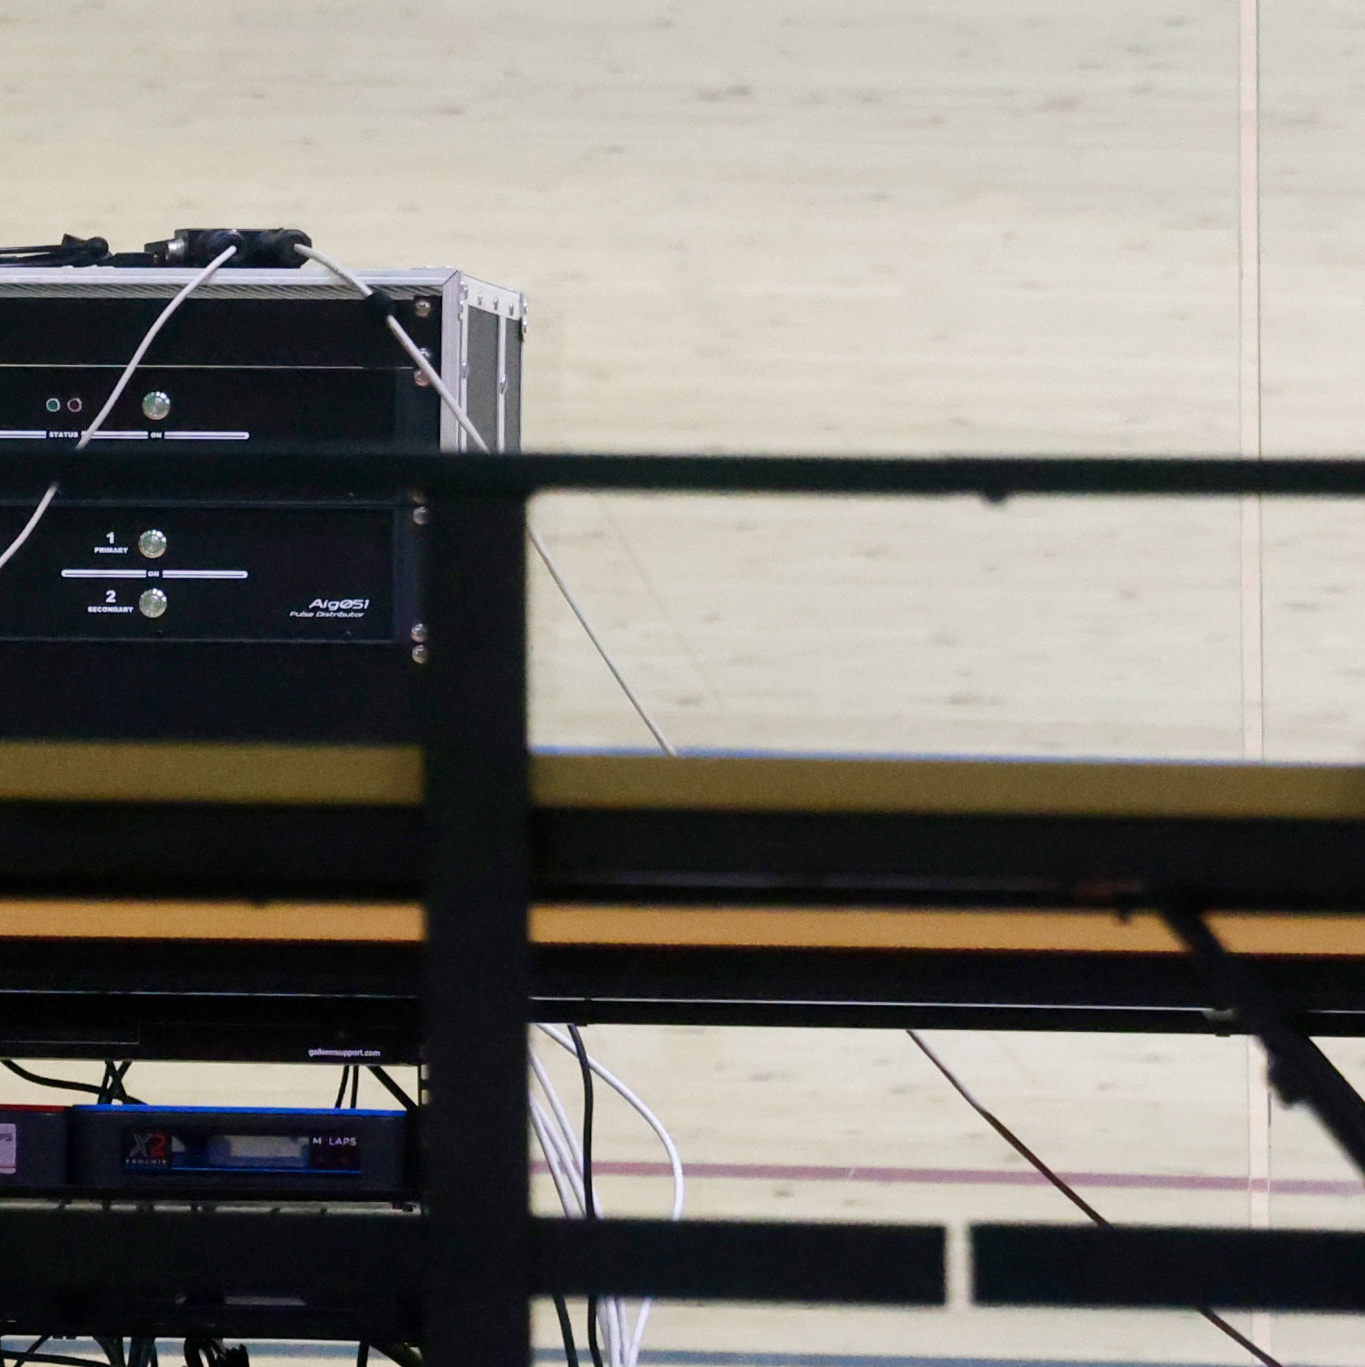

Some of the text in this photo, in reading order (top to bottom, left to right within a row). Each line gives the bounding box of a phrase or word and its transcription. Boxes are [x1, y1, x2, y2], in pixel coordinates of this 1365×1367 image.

[150, 431, 163, 439] ON
[106, 532, 115, 544] 1
[94, 546, 129, 554] PRIMARY
[147, 570, 160, 578] ON
[105, 590, 117, 603] 2
[87, 605, 134, 614] SECONDARY
